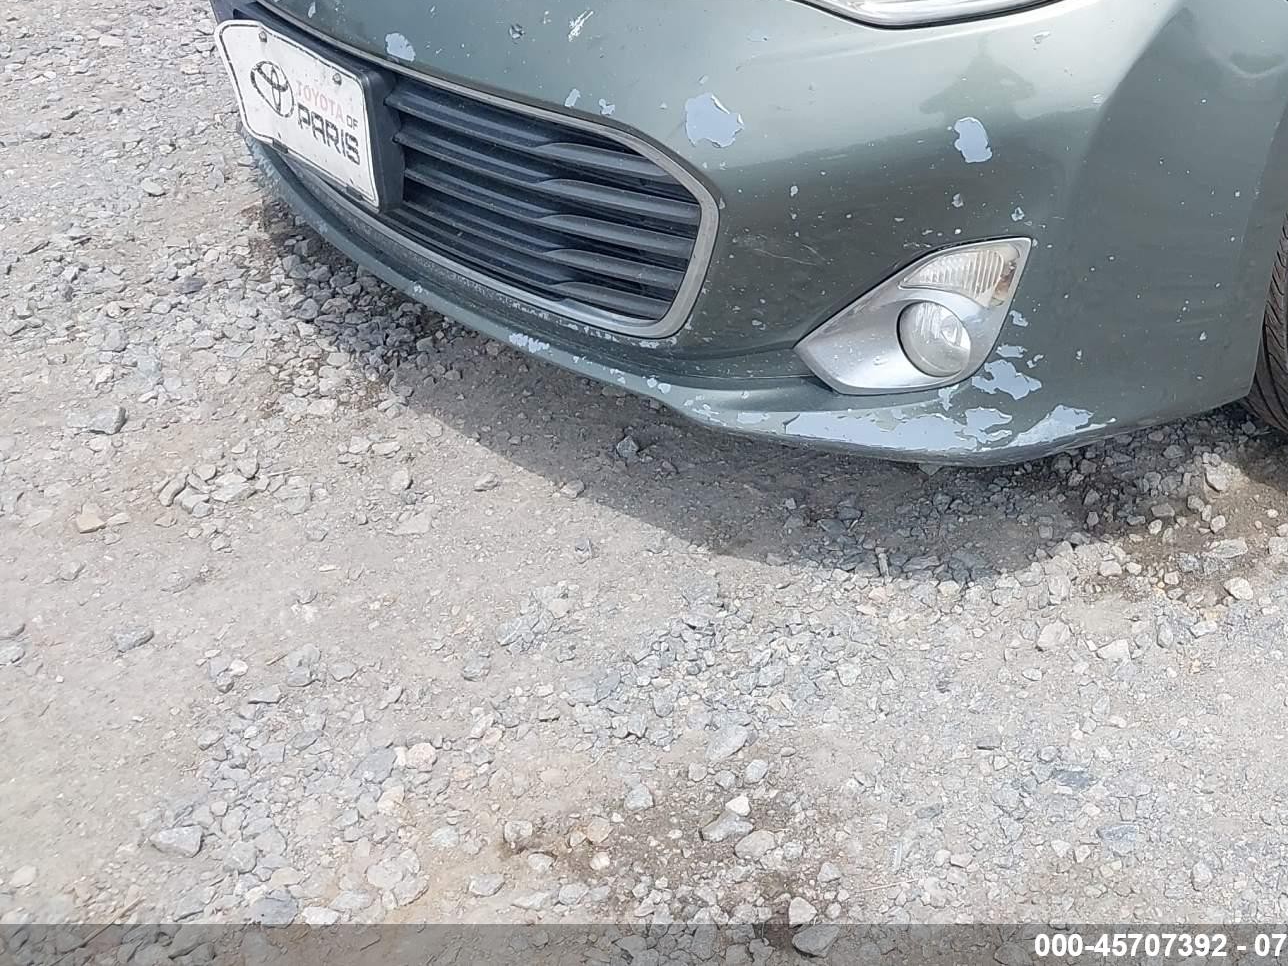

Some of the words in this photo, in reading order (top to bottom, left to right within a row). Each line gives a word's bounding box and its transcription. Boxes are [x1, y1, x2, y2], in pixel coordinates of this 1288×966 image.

[296, 80, 344, 123] TOYOTA
[347, 115, 358, 130] OF
[297, 102, 360, 165] PARIS
